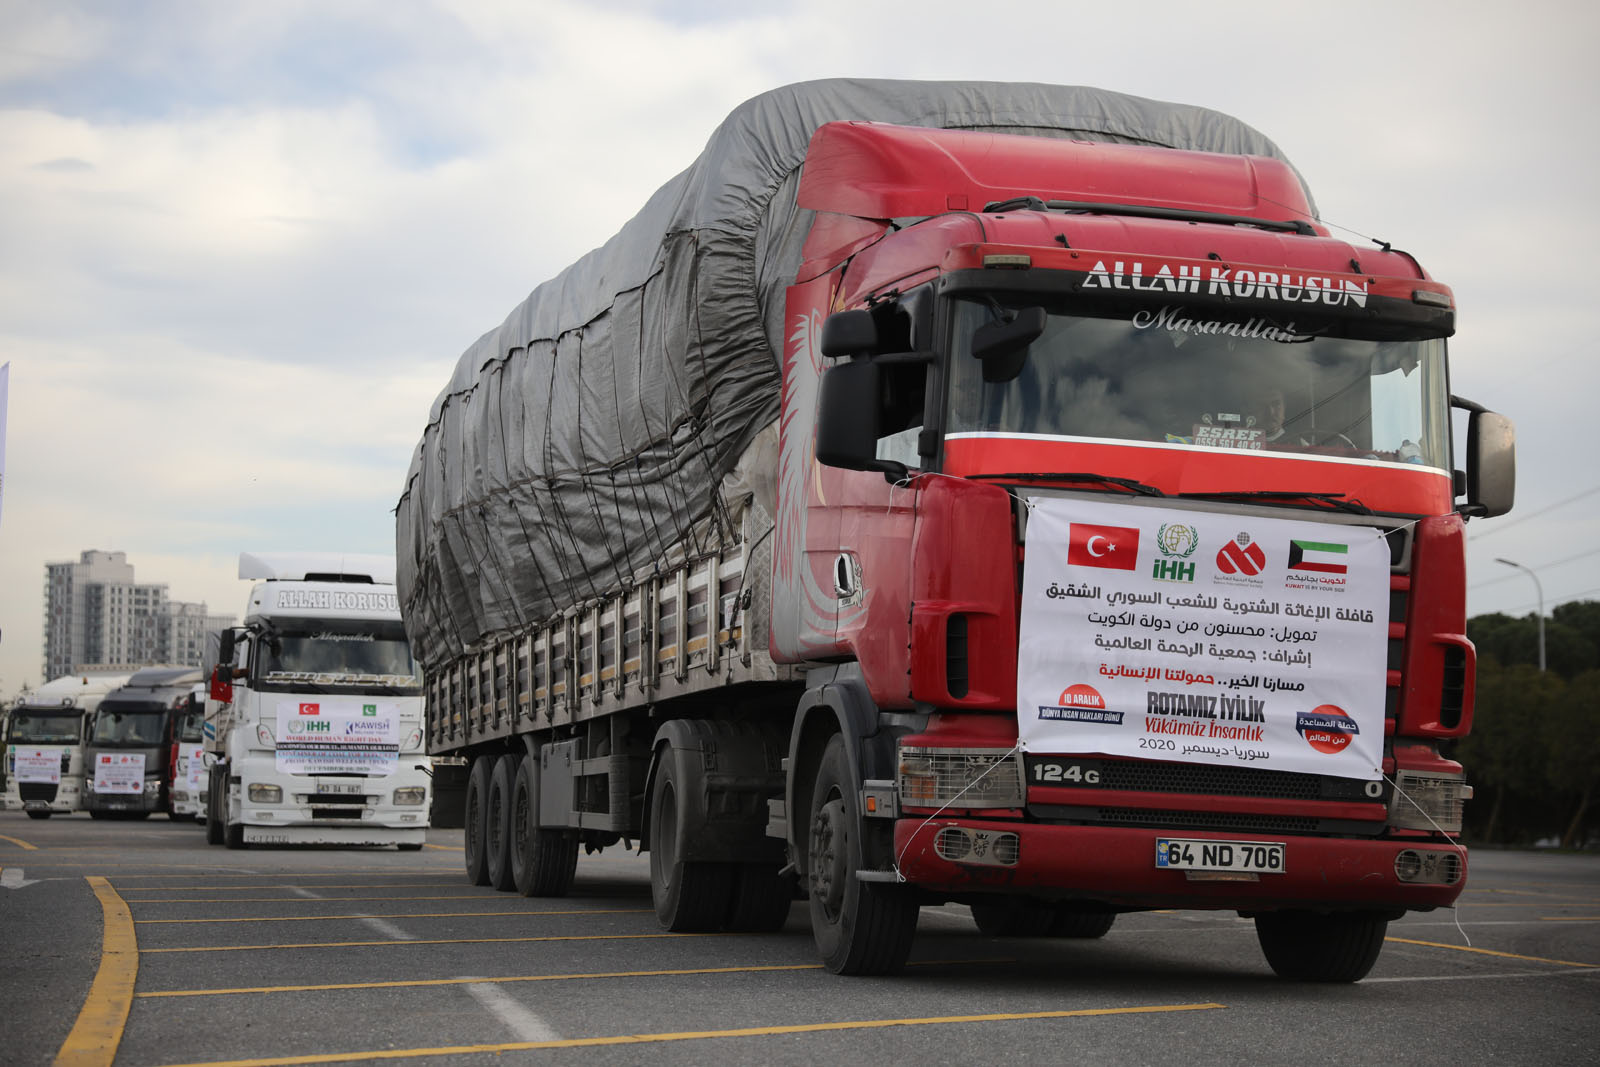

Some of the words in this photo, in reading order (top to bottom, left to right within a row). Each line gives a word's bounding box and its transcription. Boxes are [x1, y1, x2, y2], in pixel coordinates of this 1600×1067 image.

[1082, 260, 1201, 293] ALLAH
[1208, 267, 1369, 308] KORUSUN
[1046, 582, 1101, 600] الشقيق
[1106, 591, 1162, 606] السوري
[278, 590, 331, 609] ALLAH
[333, 591, 399, 612] KORUSU
[1166, 593, 1217, 609] للشعب
[1223, 598, 1280, 615] الشتوية
[1087, 611, 1135, 628] الكويت
[1284, 603, 1331, 622] الإغاثة
[1335, 608, 1374, 623] قافلة
[1139, 614, 1171, 631] دولة
[1176, 620, 1199, 634] من
[1204, 622, 1265, 637] محسنون
[1094, 634, 1152, 651] العالمية
[1270, 627, 1318, 643] تمويل:
[1157, 639, 1203, 657] الرحمة
[1208, 643, 1257, 662] جمعية
[1099, 663, 1160, 683] الإنسانية
[1164, 668, 1215, 685] حمولتنا
[1263, 676, 1305, 692] مسارنا
[1073, 694, 1101, 706] ARALIK
[1147, 691, 1217, 719] ROTAMIZ
[1220, 694, 1265, 723] İYİLİK
[1042, 708, 1061, 718] DÜNYA
[1079, 711, 1104, 721] HAKLARI
[1300, 717, 1336, 727] المساعدة
[354, 721, 390, 729] KAWISH
[1145, 717, 1206, 737] Yükümüz
[1208, 720, 1264, 742] İnsanlık
[1338, 720, 1356, 730] حملة
[1138, 738, 1176, 751] 2020
[1309, 734, 1330, 742] العالم
[1332, 736, 1346, 744] من
[1168, 843, 1194, 866] 64
[1202, 845, 1233, 867] ND
[1241, 846, 1280, 869] 706
